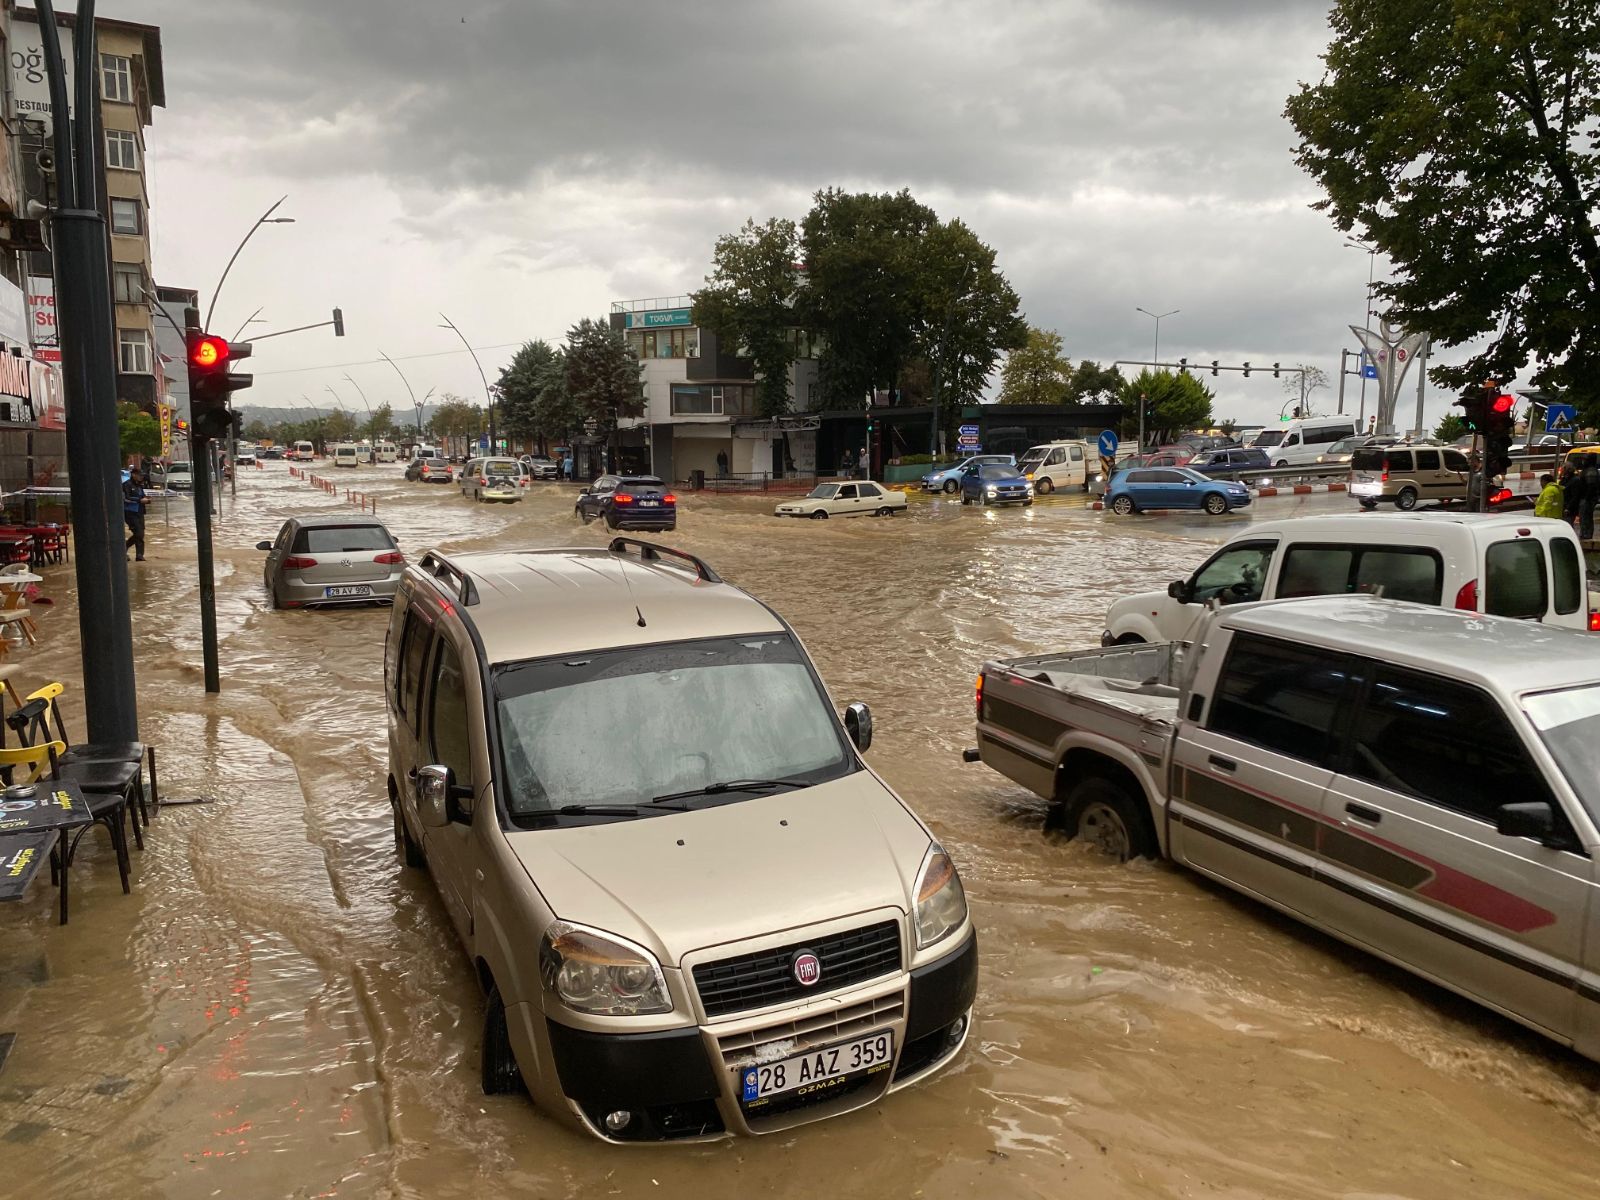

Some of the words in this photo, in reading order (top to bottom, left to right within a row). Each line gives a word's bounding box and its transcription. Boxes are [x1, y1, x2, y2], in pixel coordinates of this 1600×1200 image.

[800, 962, 815, 978] FIAT
[760, 1064, 786, 1094] 28
[799, 1049, 840, 1083] AAZ
[850, 1036, 887, 1068] 359
[747, 1086, 757, 1094] TR
